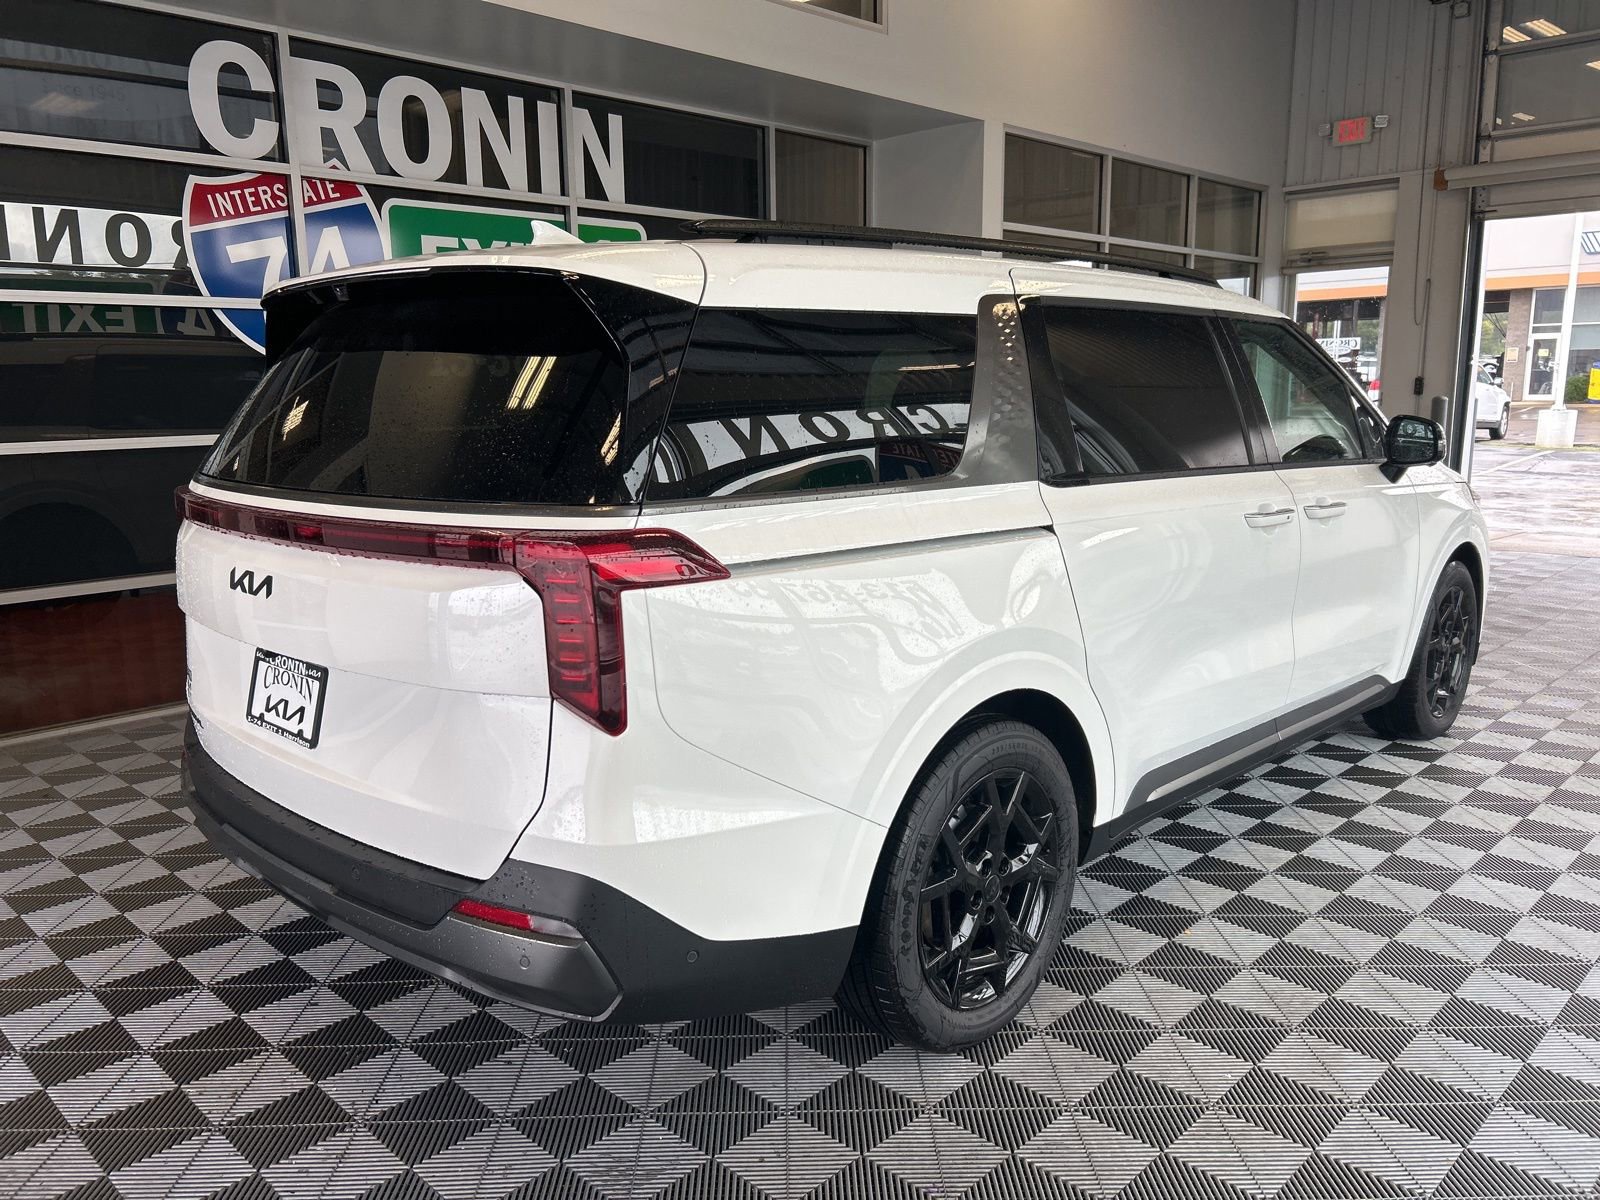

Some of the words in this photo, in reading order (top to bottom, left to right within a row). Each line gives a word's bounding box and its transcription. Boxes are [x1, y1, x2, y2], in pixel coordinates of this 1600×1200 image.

[188, 39, 624, 203] CRONIN
[207, 178, 341, 218] INTERSATE
[230, 567, 273, 599] KIA
[270, 655, 306, 676] CRONIN
[264, 665, 315, 705] CRONIN
[264, 693, 306, 726] KIA
